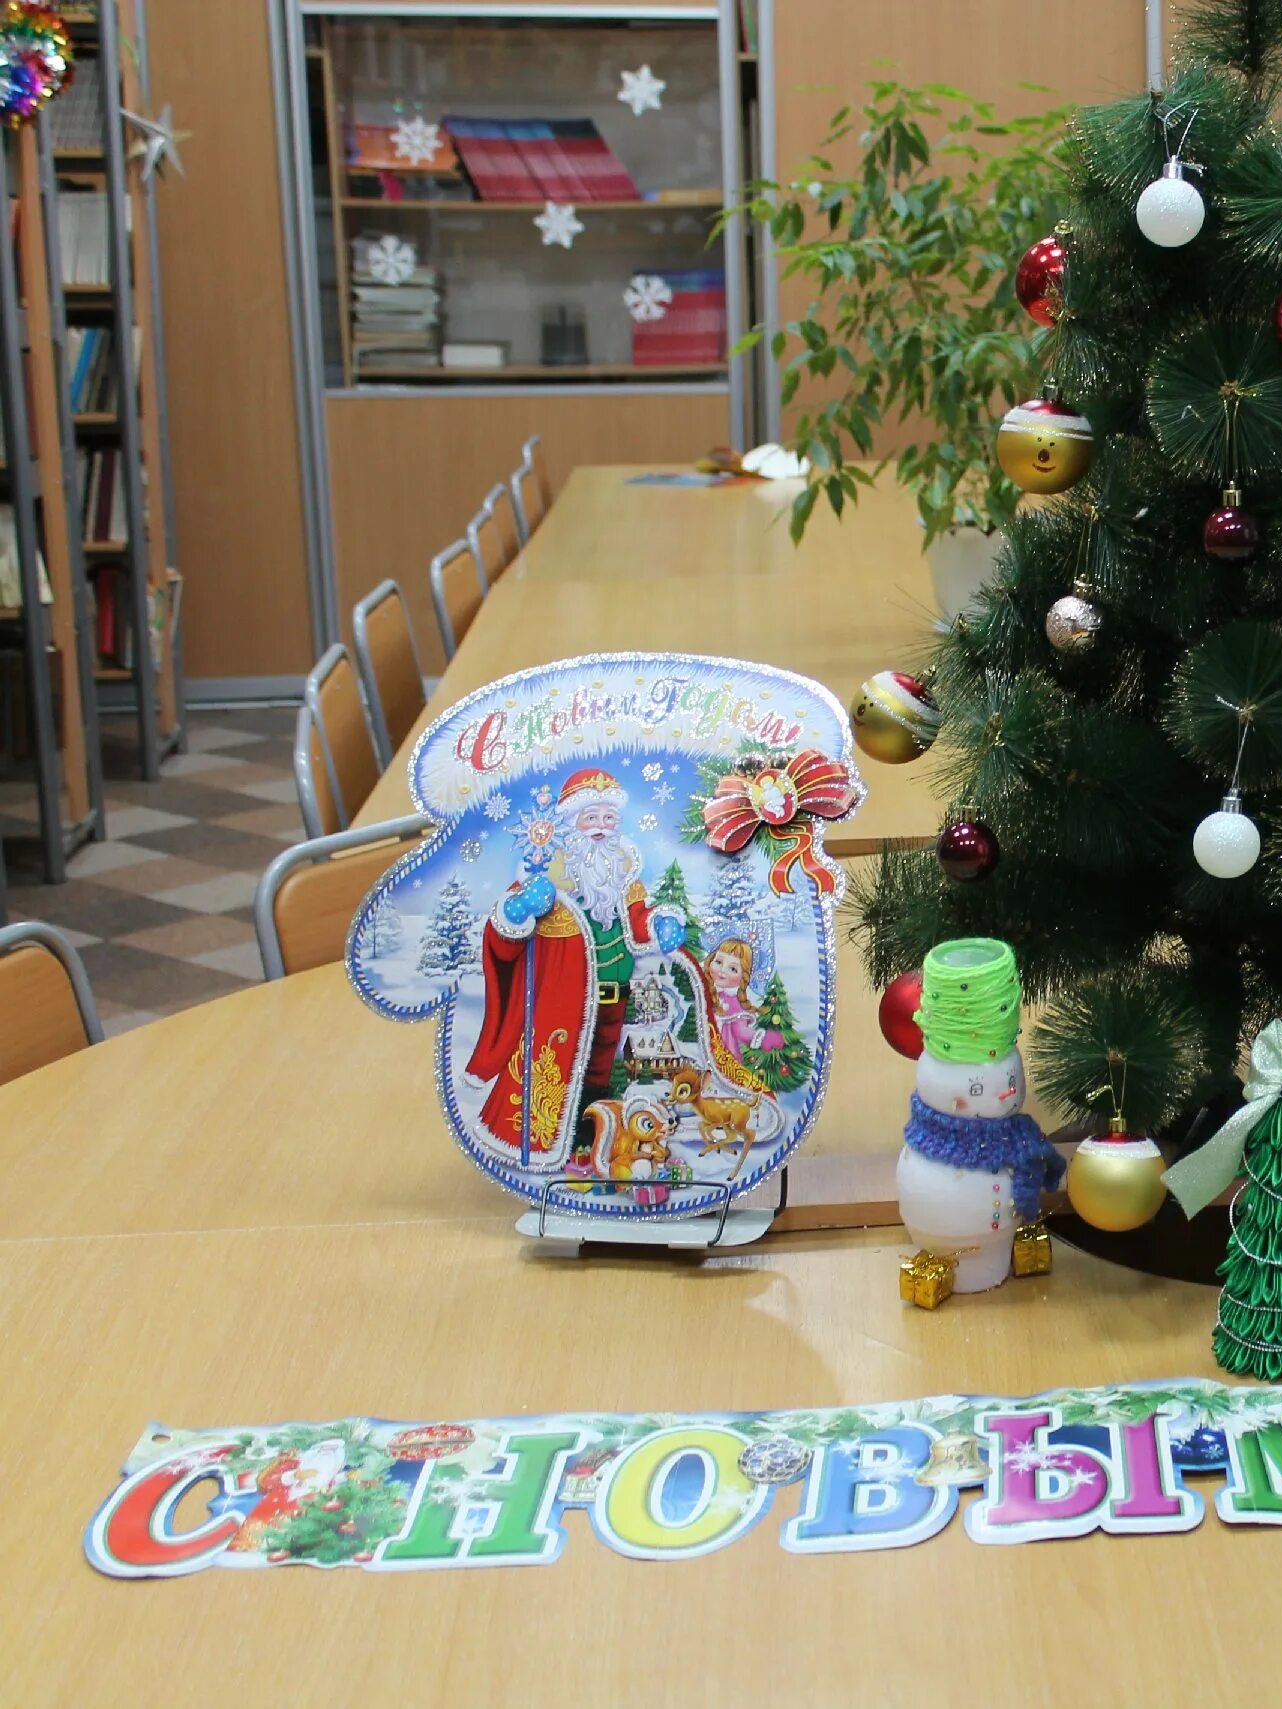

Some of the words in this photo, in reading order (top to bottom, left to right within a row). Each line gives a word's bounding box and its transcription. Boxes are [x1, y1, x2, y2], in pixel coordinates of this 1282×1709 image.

[455, 709, 507, 773] С
[509, 687, 639, 753] Новым
[643, 676, 802, 746] Годом!
[102, 1442, 242, 1570] С
